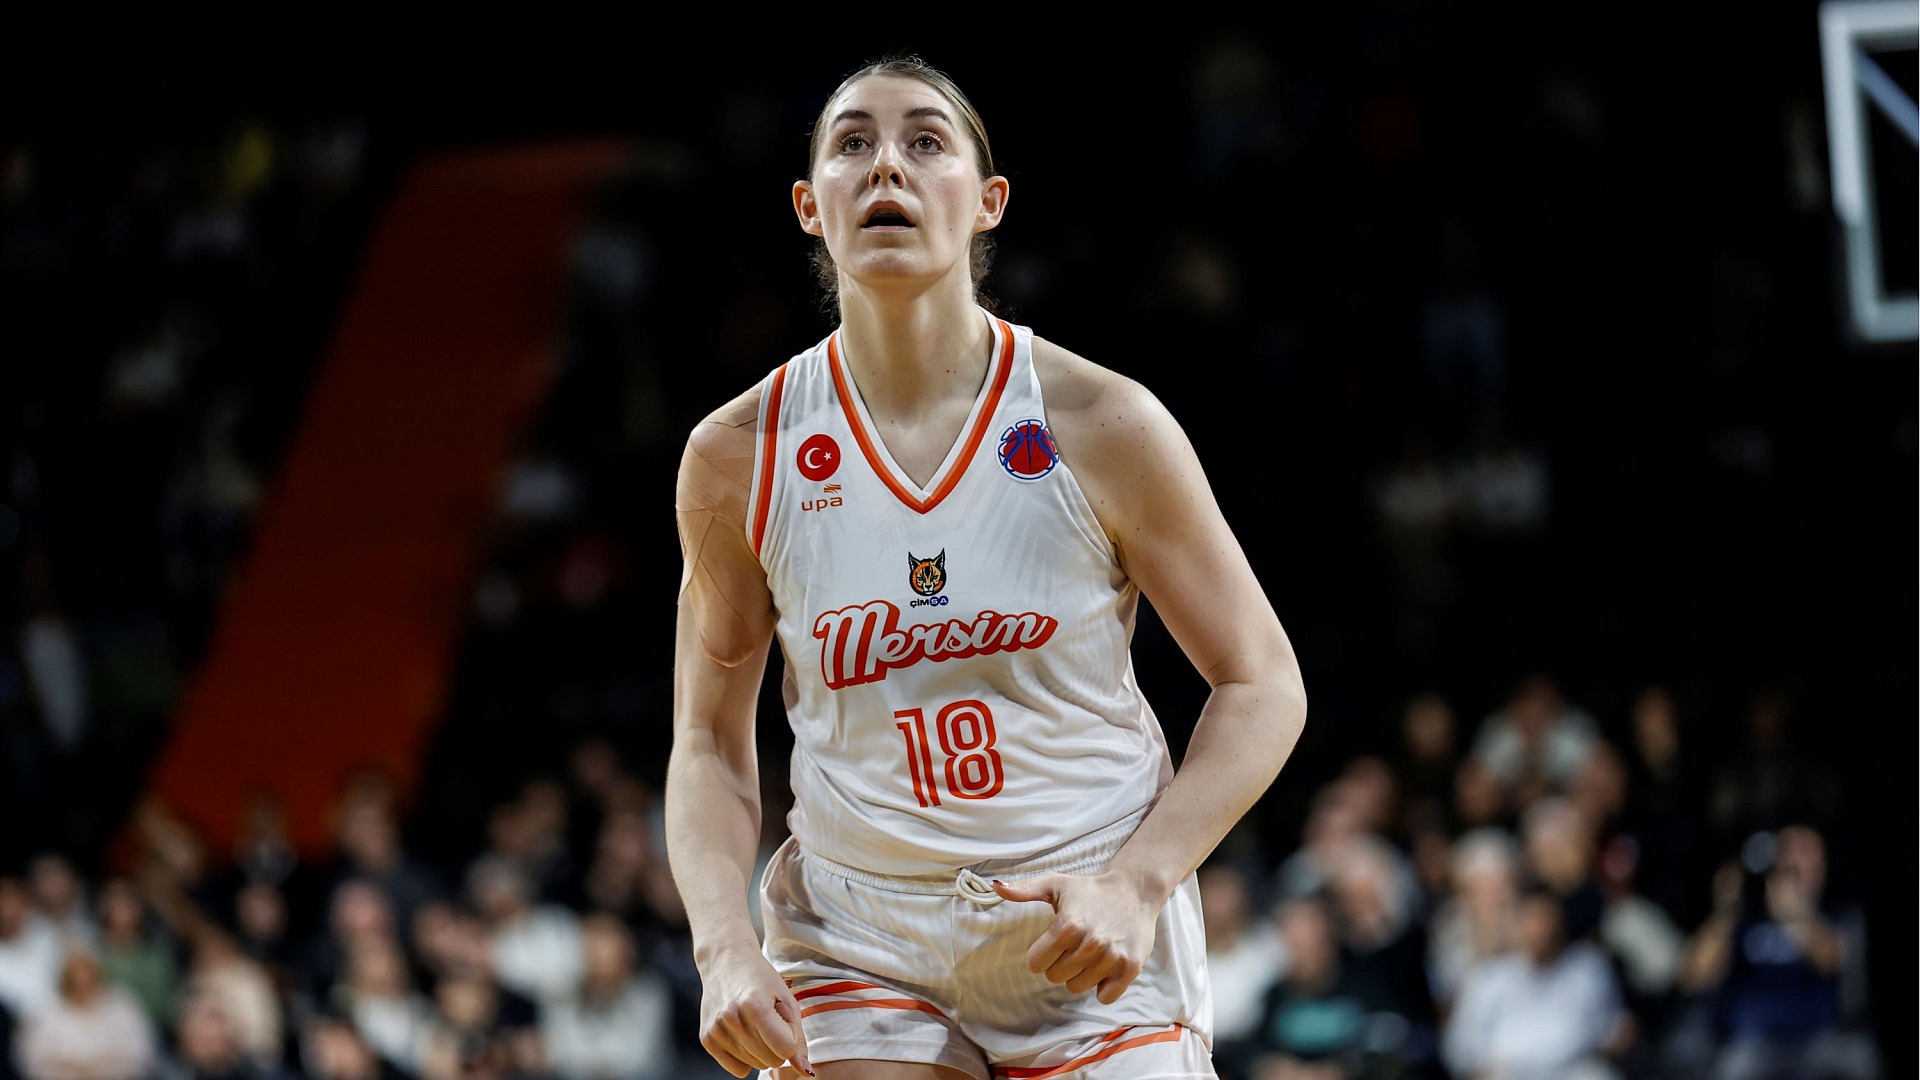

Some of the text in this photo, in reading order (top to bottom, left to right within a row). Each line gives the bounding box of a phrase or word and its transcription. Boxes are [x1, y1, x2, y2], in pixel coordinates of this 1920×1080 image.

[801, 497, 843, 512] upa
[813, 600, 1058, 690] Mersin
[894, 699, 1004, 808] 18
